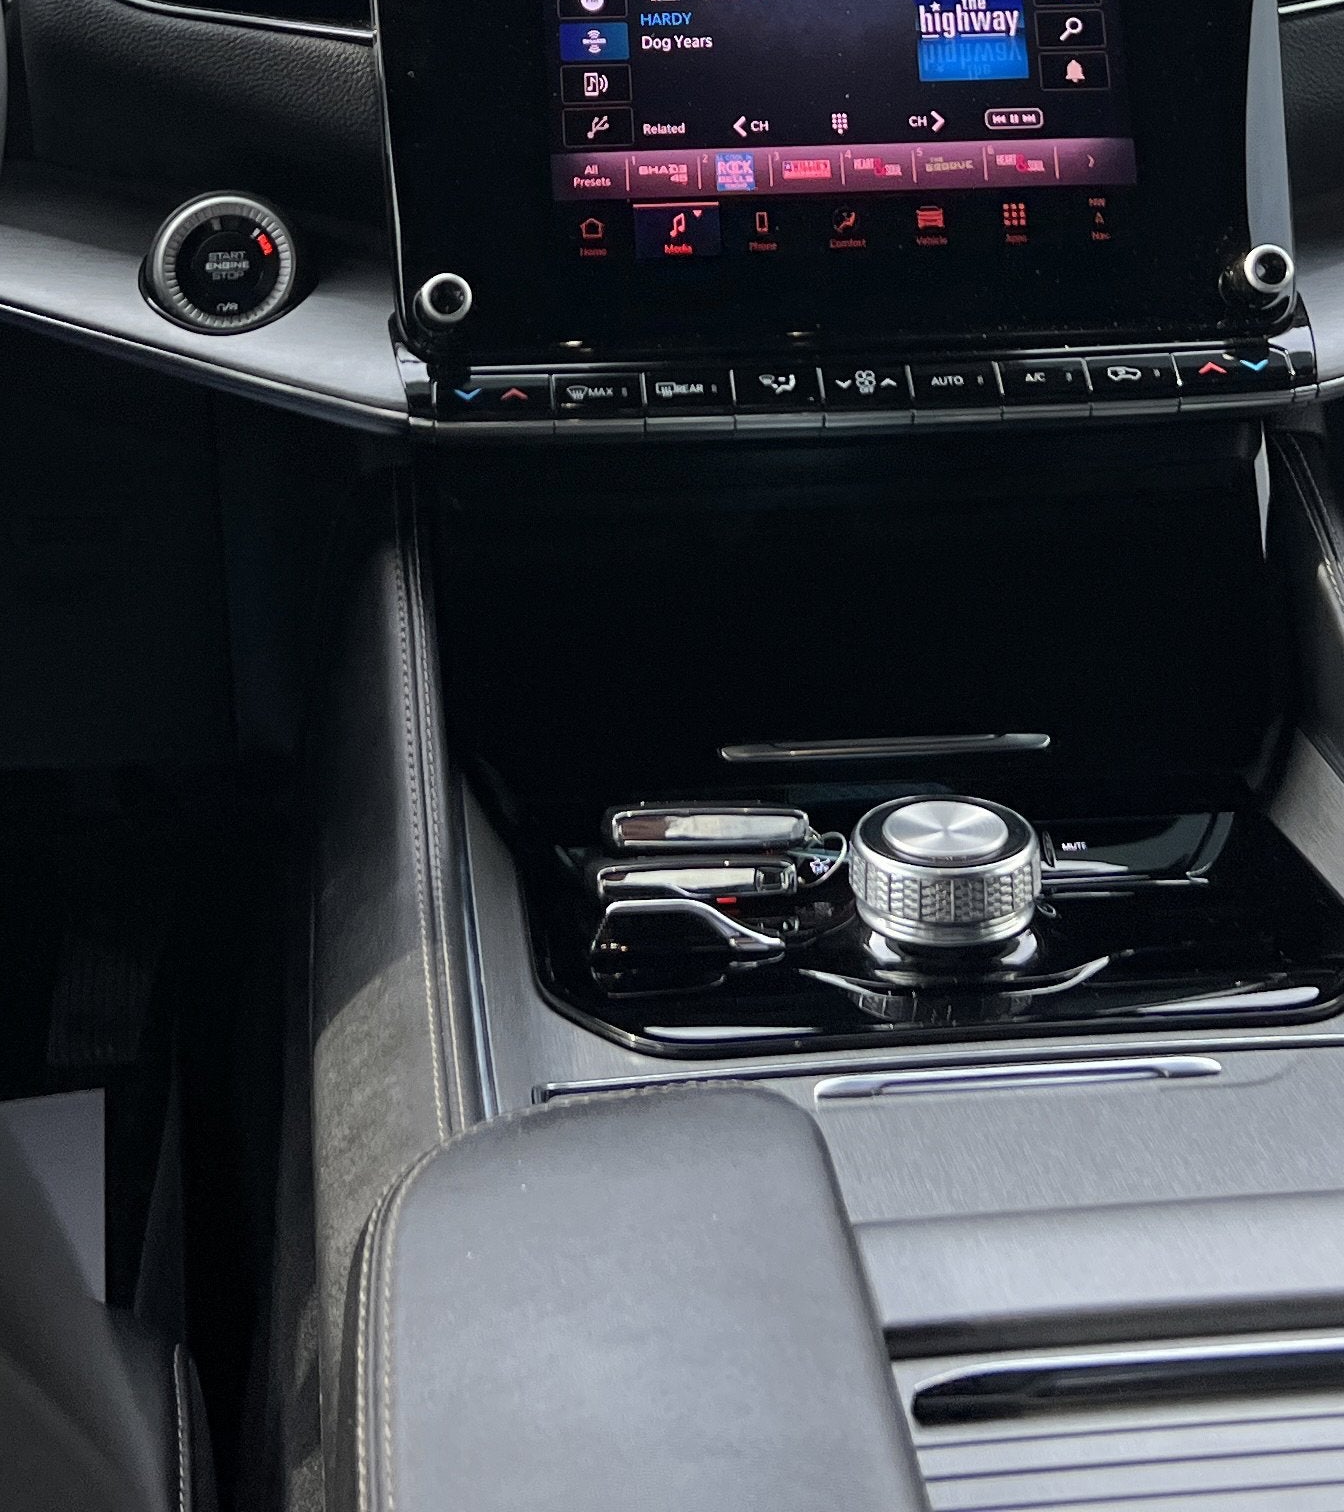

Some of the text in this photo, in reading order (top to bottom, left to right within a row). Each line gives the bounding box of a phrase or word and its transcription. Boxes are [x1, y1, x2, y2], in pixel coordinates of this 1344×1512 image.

[640, 12, 692, 26] HARDY
[919, 4, 1019, 38] highway
[641, 34, 713, 52] Dog Years
[751, 120, 769, 132] CH
[908, 116, 928, 128] CH
[643, 123, 686, 135] Related
[584, 165, 599, 175] All
[717, 160, 753, 177] ROCK
[573, 176, 612, 189] Presets
[208, 251, 245, 261] START
[205, 261, 250, 271] ENGINE
[212, 270, 244, 280] STOP
[931, 375, 964, 387] AUTO
[1025, 372, 1046, 383] A/C
[588, 388, 613, 397] MAX
[674, 384, 704, 394] REAR
